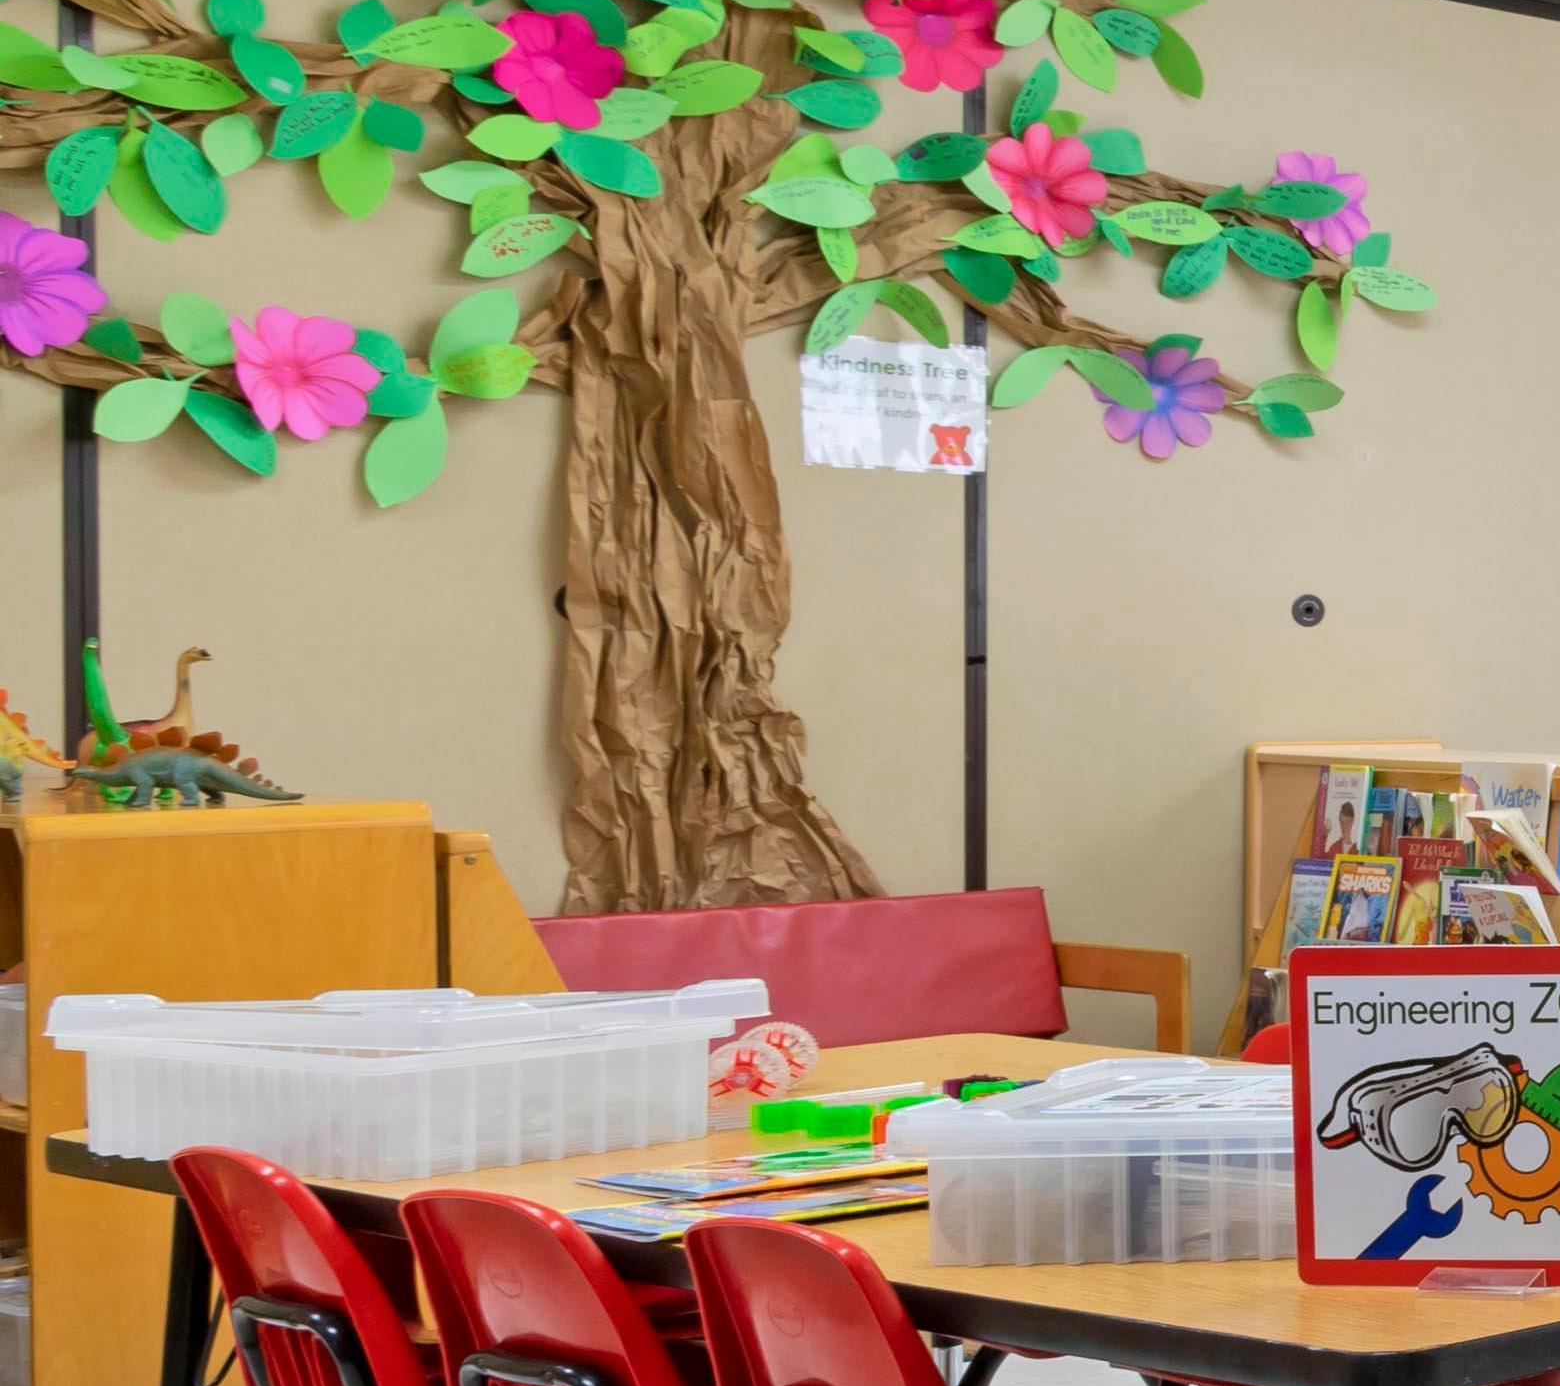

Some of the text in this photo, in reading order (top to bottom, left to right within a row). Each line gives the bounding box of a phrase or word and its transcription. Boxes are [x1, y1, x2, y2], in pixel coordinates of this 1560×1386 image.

[820, 353, 968, 380] Kindness Tree
[1491, 783, 1541, 808] Water
[1339, 873, 1392, 894] SHARKS
[1313, 991, 1515, 1034] Engineering
